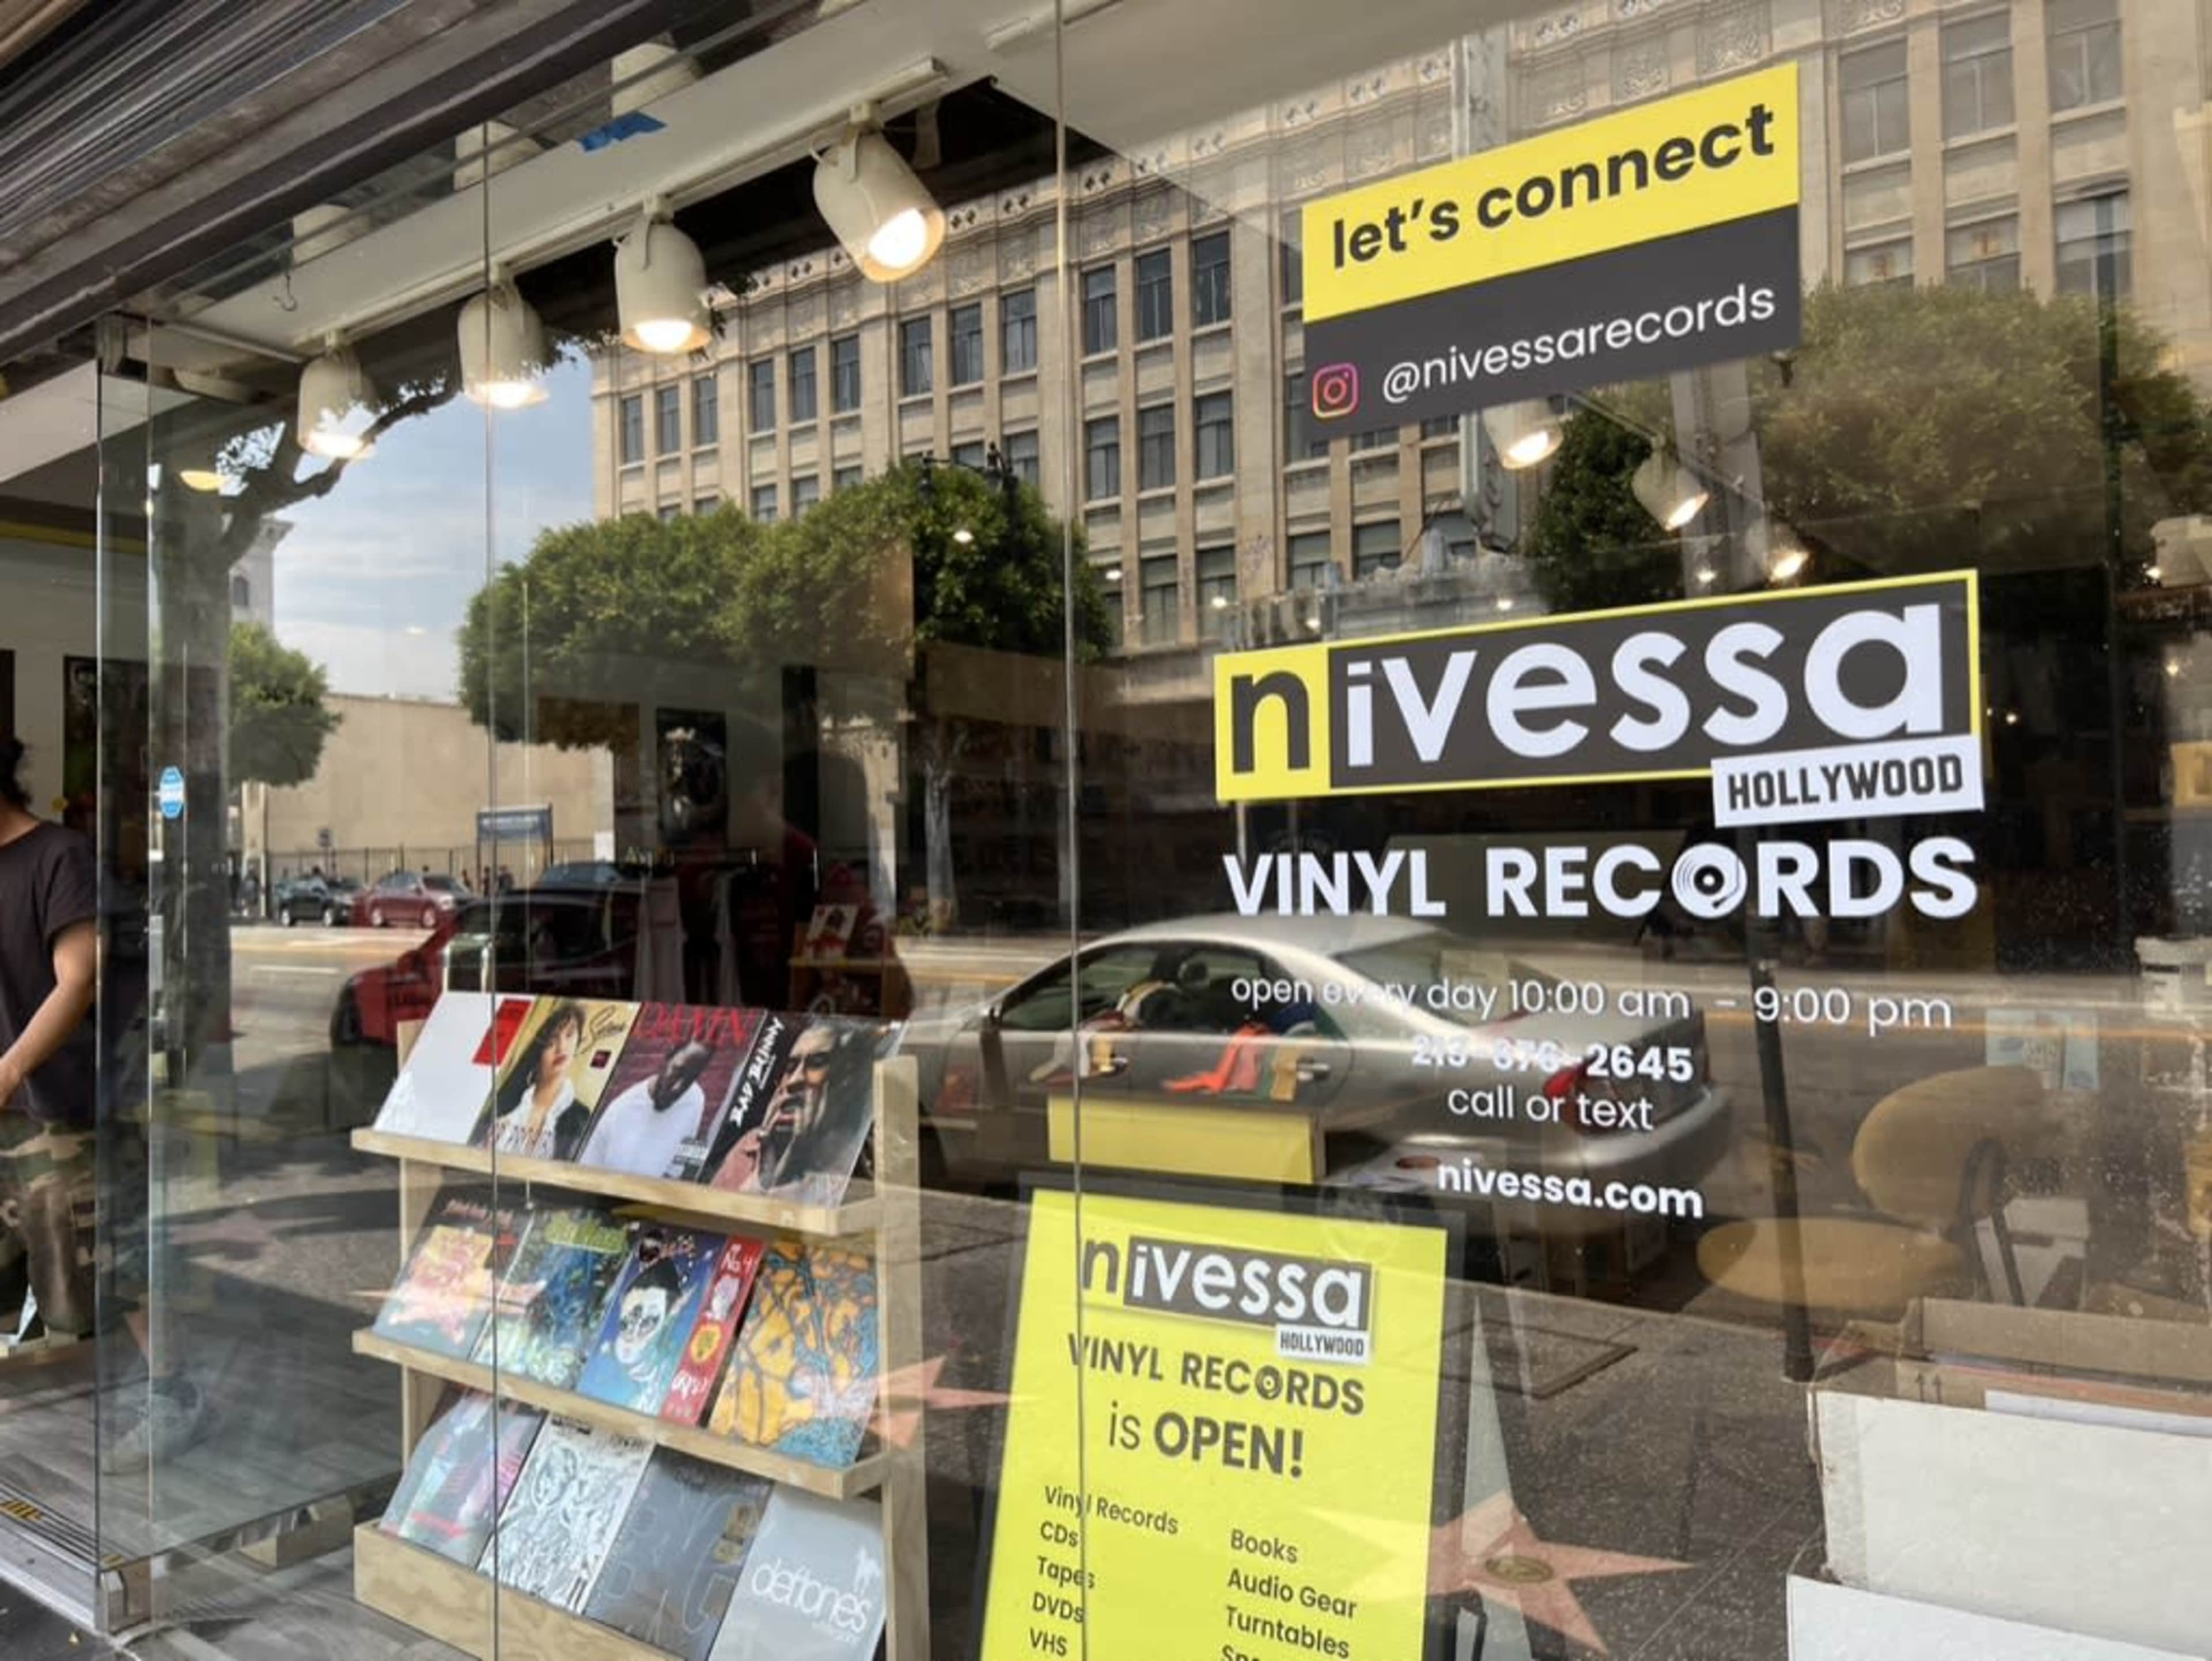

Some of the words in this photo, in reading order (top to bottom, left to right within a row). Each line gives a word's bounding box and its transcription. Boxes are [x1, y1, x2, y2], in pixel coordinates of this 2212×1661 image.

[1478, 103, 1774, 228] connect
[1383, 283, 1775, 403] @nivessarecords
[1230, 604, 1943, 775] nivessa
[1728, 754, 1962, 811] HOLLYWOOD
[1224, 848, 1445, 917] VINYL
[1487, 837, 1978, 919] RECORDS
[1232, 977, 1312, 1010] open
[1427, 979, 1497, 1019] day
[1509, 980, 1605, 1015] 10:00
[1619, 989, 1689, 1019] am
[1754, 988, 1850, 1023] 9:00
[1870, 996, 1952, 1037] pm
[1448, 1086, 1513, 1118] call
[1527, 1095, 1567, 1123] or
[1577, 1093, 1653, 1131] text
[1437, 1162, 1703, 1220] nivessa.com
[1082, 1239, 1362, 1328] nivessa
[1280, 1332, 1364, 1356] HOLLYWOOD
[1068, 1333, 1164, 1381] VINYL
[1181, 1353, 1365, 1416] RECORDS
[1109, 1400, 1141, 1451] is
[1154, 1411, 1304, 1478] OPEN!
[1040, 1520, 1079, 1548] CDs
[1045, 1485, 1092, 1519] Vinyl
[1097, 1496, 1179, 1535] Records
[1037, 1555, 1096, 1589] Tapes
[1231, 1528, 1298, 1564] Books
[1032, 1591, 1085, 1624] DVDs
[1228, 1567, 1293, 1603] Audio
[1300, 1585, 1358, 1620] Gear
[1030, 1626, 1068, 1658] VHS
[1226, 1605, 1350, 1659] Turntables
